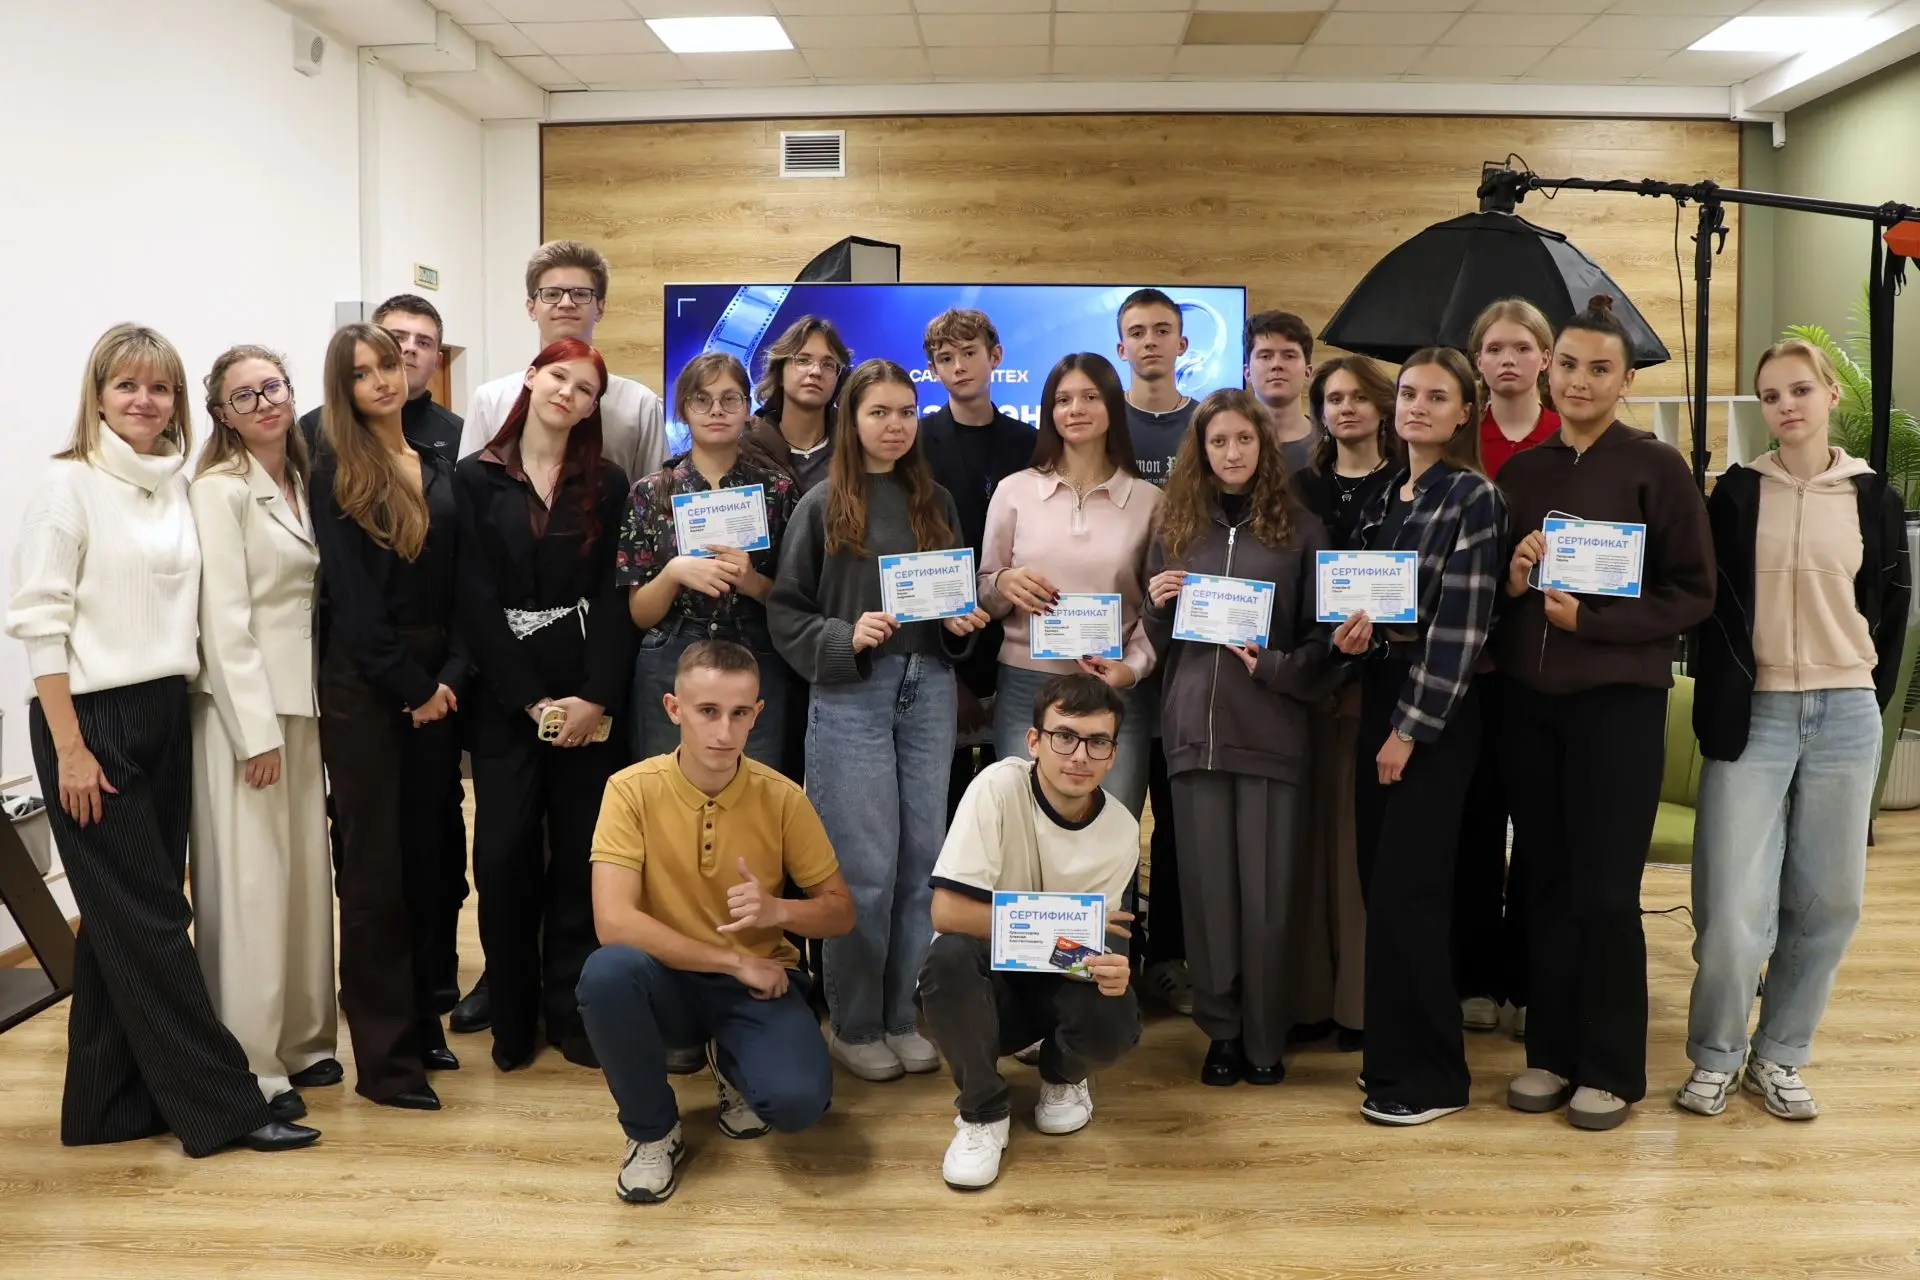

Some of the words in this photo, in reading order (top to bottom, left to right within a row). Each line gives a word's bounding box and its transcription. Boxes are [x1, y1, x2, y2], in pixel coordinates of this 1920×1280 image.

[687, 501, 752, 517] СЕРТИФИКАТ
[1557, 536, 1629, 549] СЕРТИФИКАТ
[894, 565, 961, 579] СЕРТИФИКАТ
[1331, 567, 1402, 577] СЕРТИФИКАТ
[1192, 589, 1259, 605] СЕРТИФИКАТ
[1009, 910, 1089, 922] СЕРТИФИКАТ
